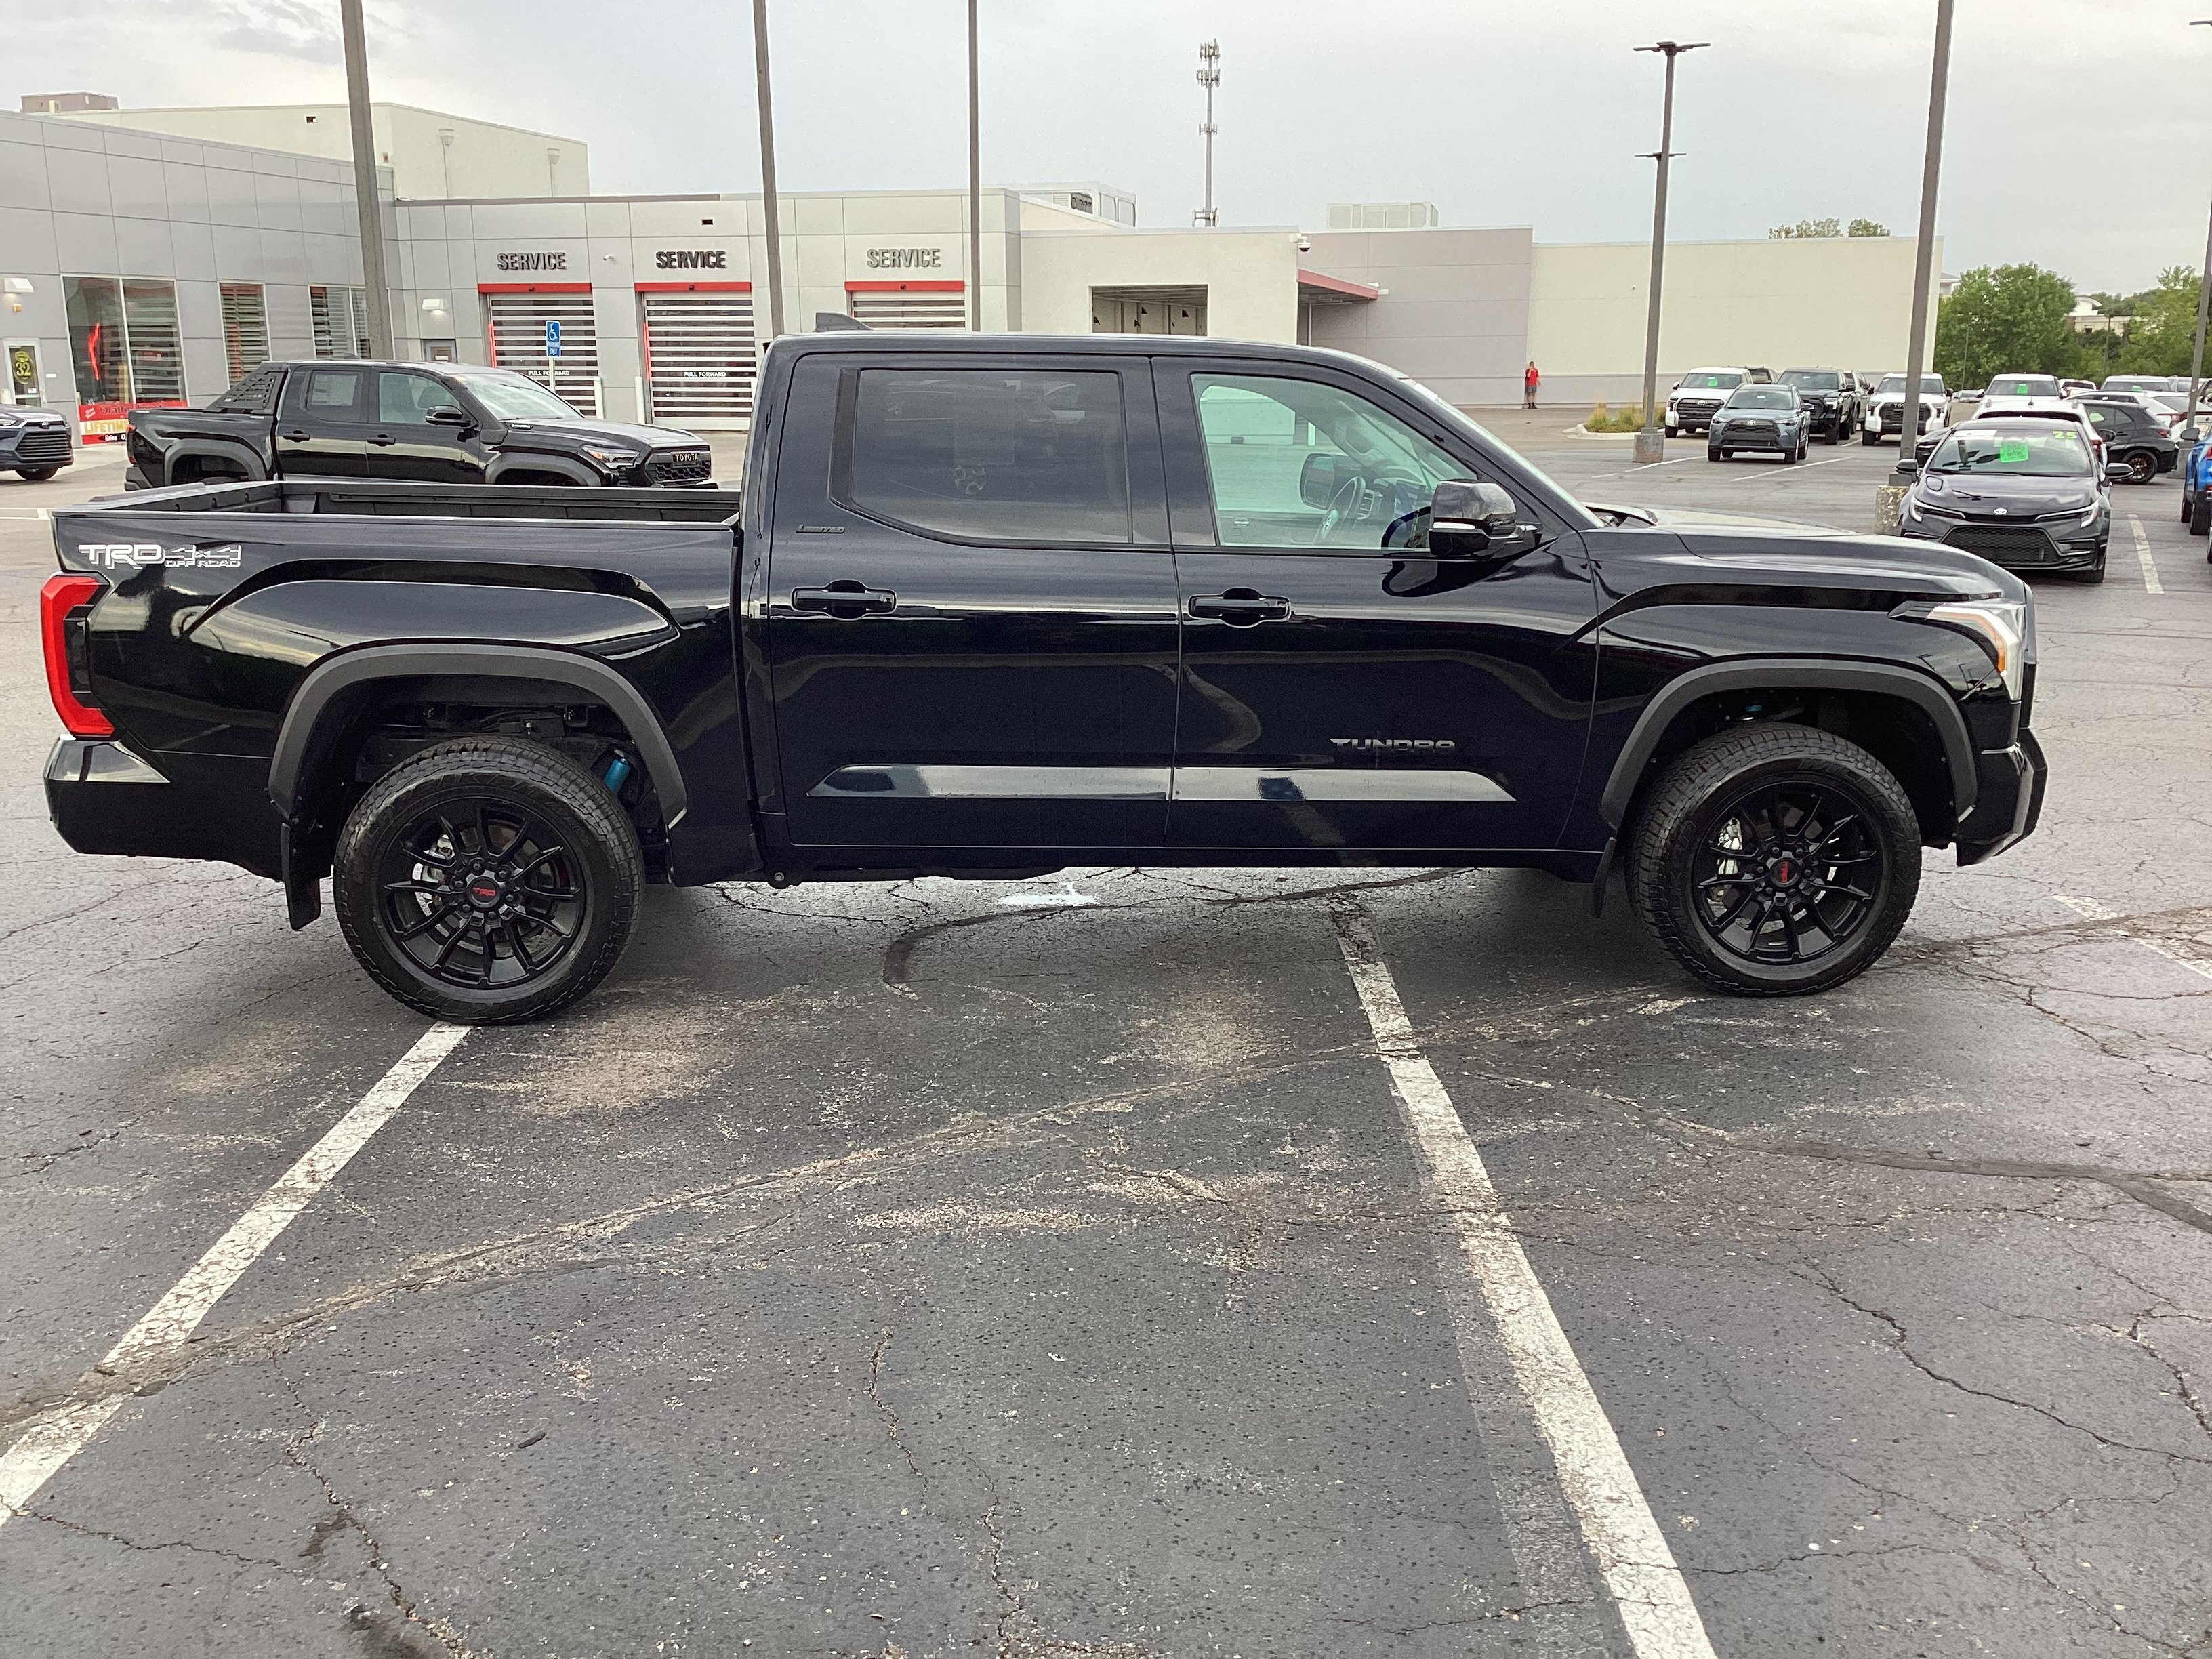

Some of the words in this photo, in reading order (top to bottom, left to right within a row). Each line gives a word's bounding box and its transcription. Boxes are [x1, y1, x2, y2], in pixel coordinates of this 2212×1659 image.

[497, 252, 567, 270] SERVICE
[655, 251, 726, 268] SERVICE
[867, 248, 941, 268] SERVICE
[16, 362, 31, 376] 32
[2053, 430, 2078, 439] 25
[675, 453, 699, 462] TOYOTA
[79, 544, 165, 569] TRD
[1330, 738, 1456, 753] TUNDRA
